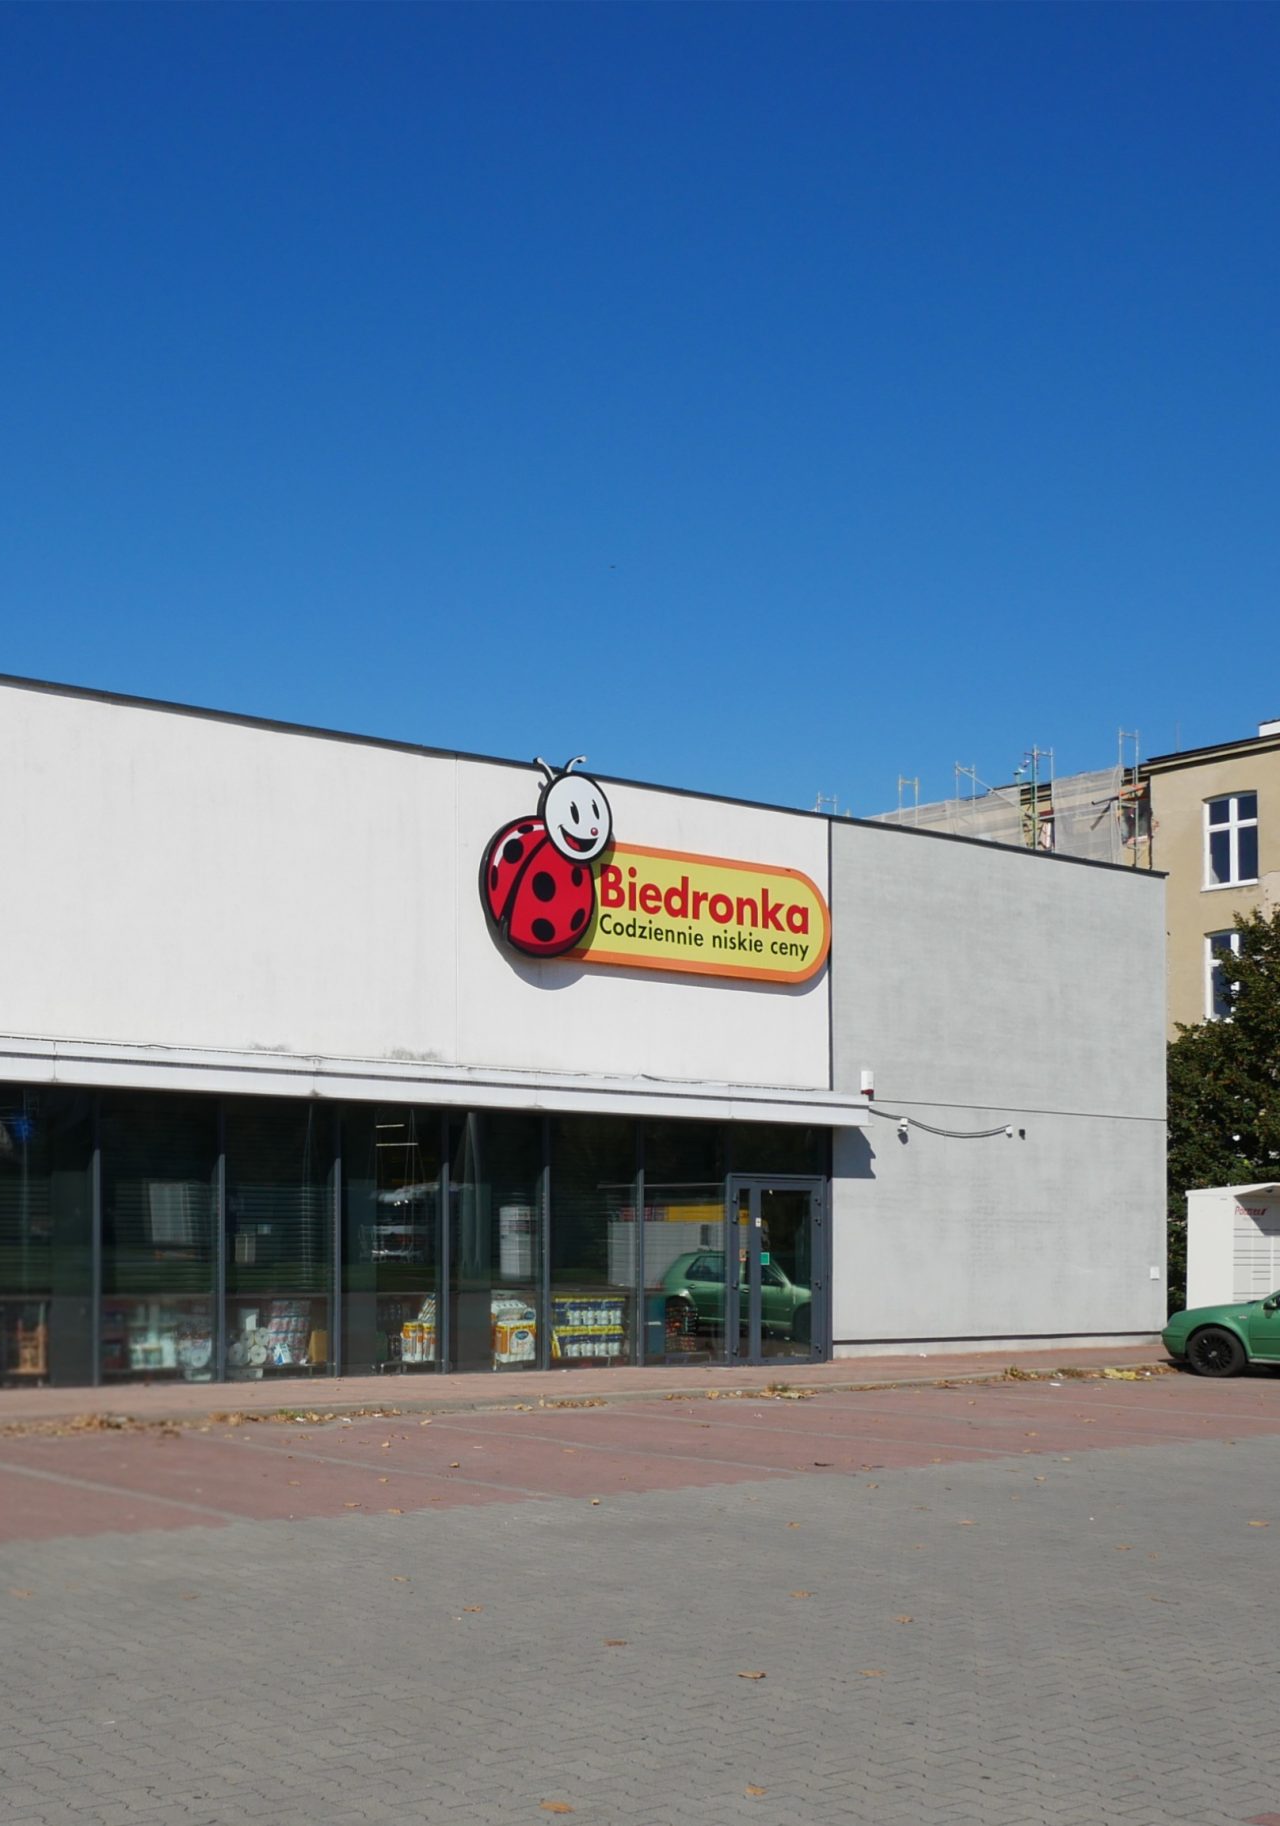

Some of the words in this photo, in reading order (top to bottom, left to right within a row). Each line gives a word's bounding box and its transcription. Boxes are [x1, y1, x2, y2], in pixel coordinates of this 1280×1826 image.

[600, 863, 809, 935] Biedronka
[599, 914, 704, 946] Codziennie
[712, 929, 763, 952] niskie
[770, 940, 809, 961] ceny
